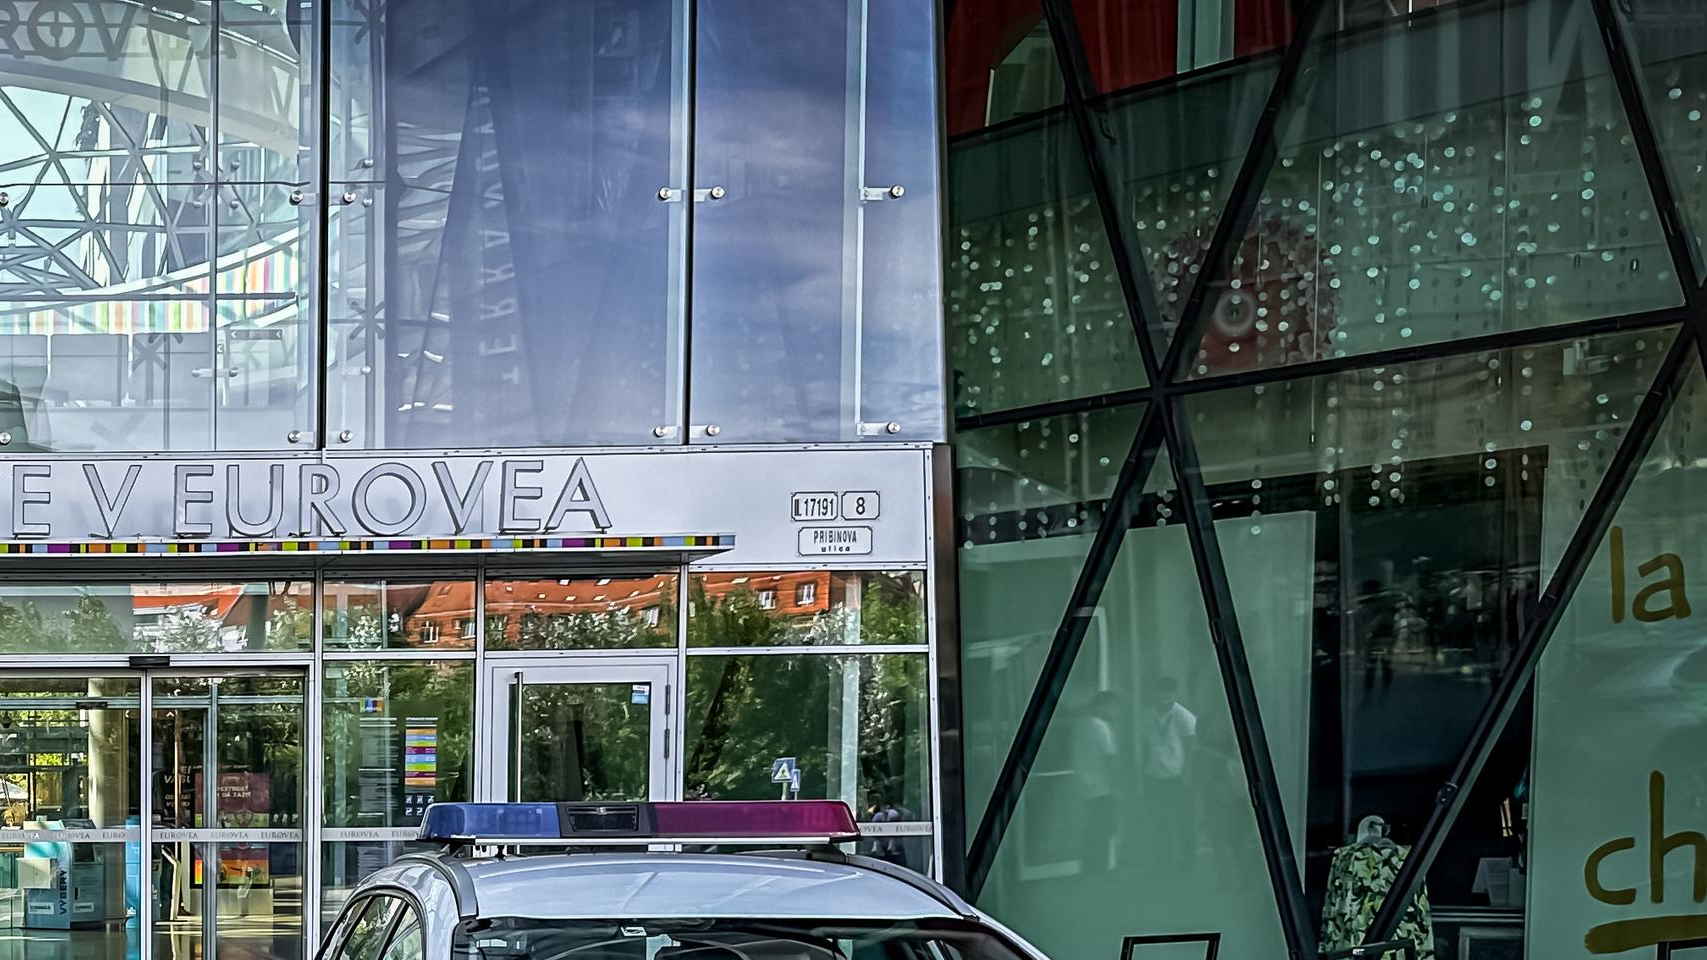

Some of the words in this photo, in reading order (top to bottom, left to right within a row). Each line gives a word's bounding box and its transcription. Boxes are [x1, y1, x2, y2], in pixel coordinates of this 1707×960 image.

[82, 464, 142, 536] V
[174, 457, 612, 536] EUROVEA
[804, 498, 834, 516] 17191
[856, 497, 865, 515] 8
[813, 530, 857, 543] PRIBINOVA
[1610, 525, 1691, 624] la
